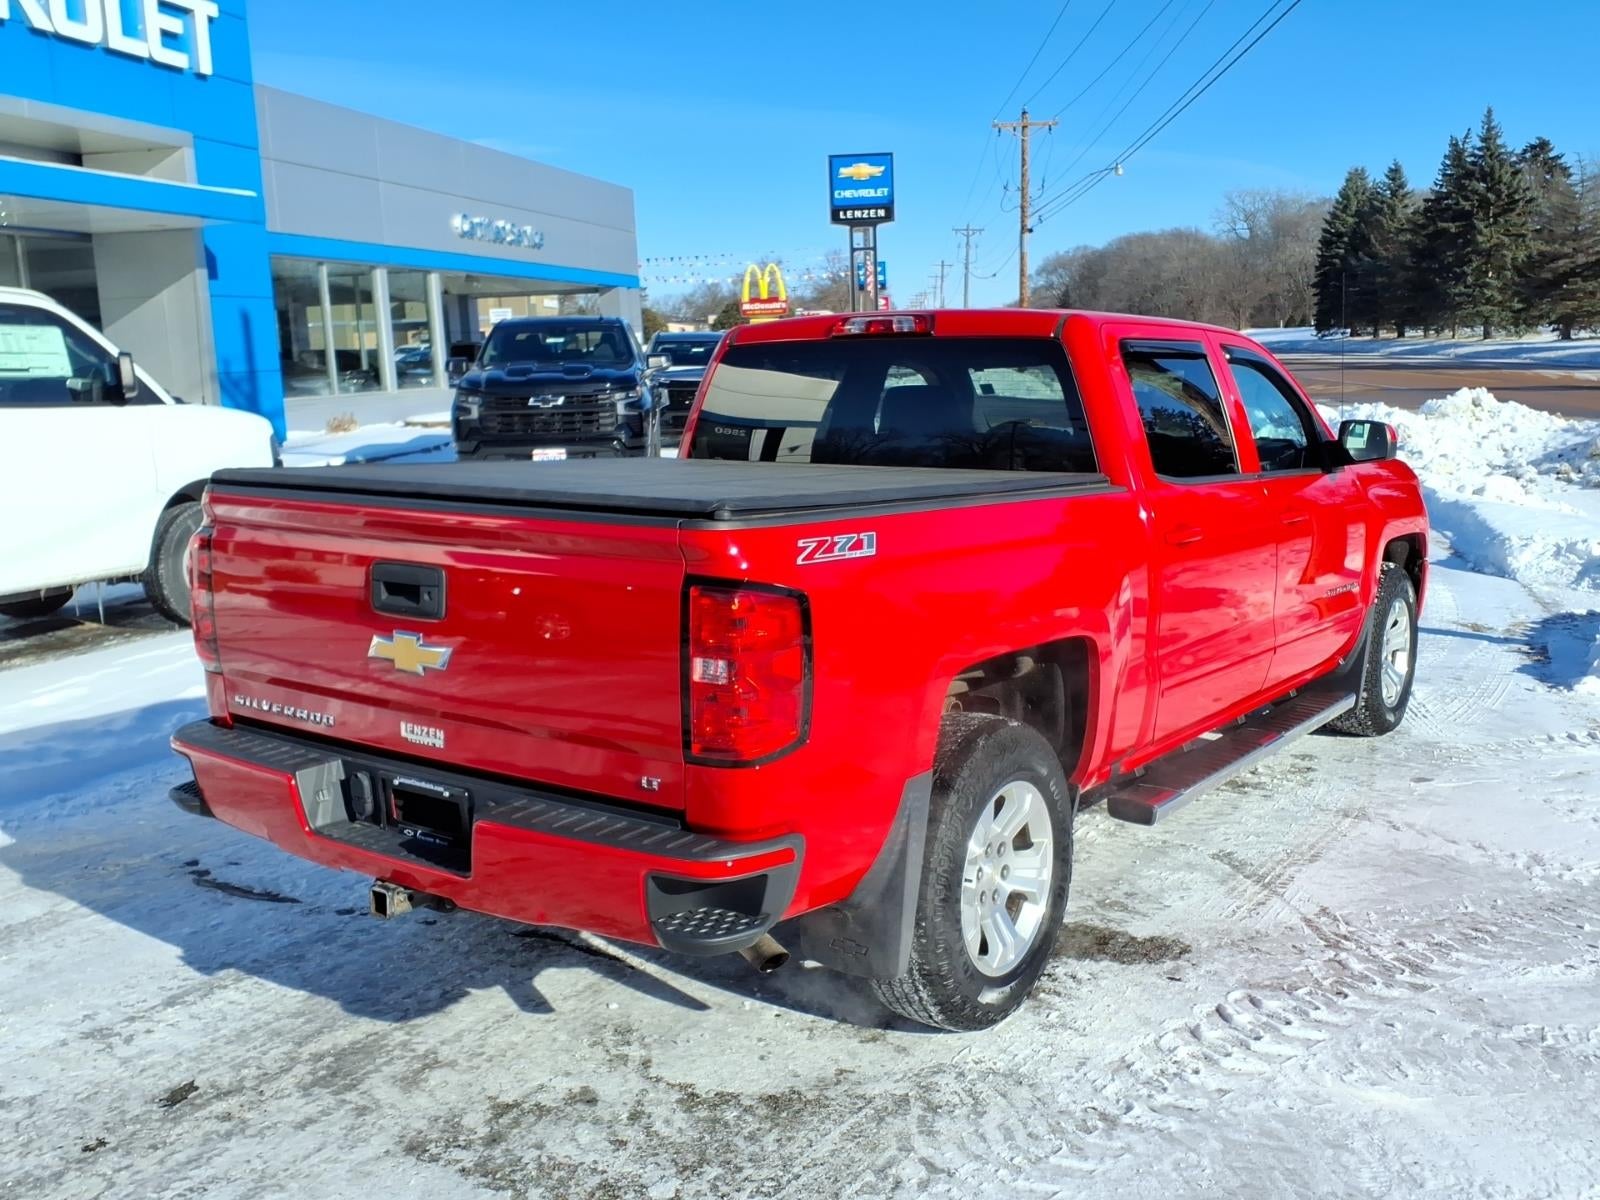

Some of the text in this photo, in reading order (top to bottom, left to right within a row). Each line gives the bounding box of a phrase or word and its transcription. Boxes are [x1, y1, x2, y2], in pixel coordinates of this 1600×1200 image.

[834, 187, 889, 199] CHEVROLET
[839, 208, 886, 219] LENZEN
[796, 531, 877, 565] Z71
[234, 694, 336, 727] SILVERADO
[400, 720, 445, 742] LENZEN
[641, 775, 661, 791] LT
